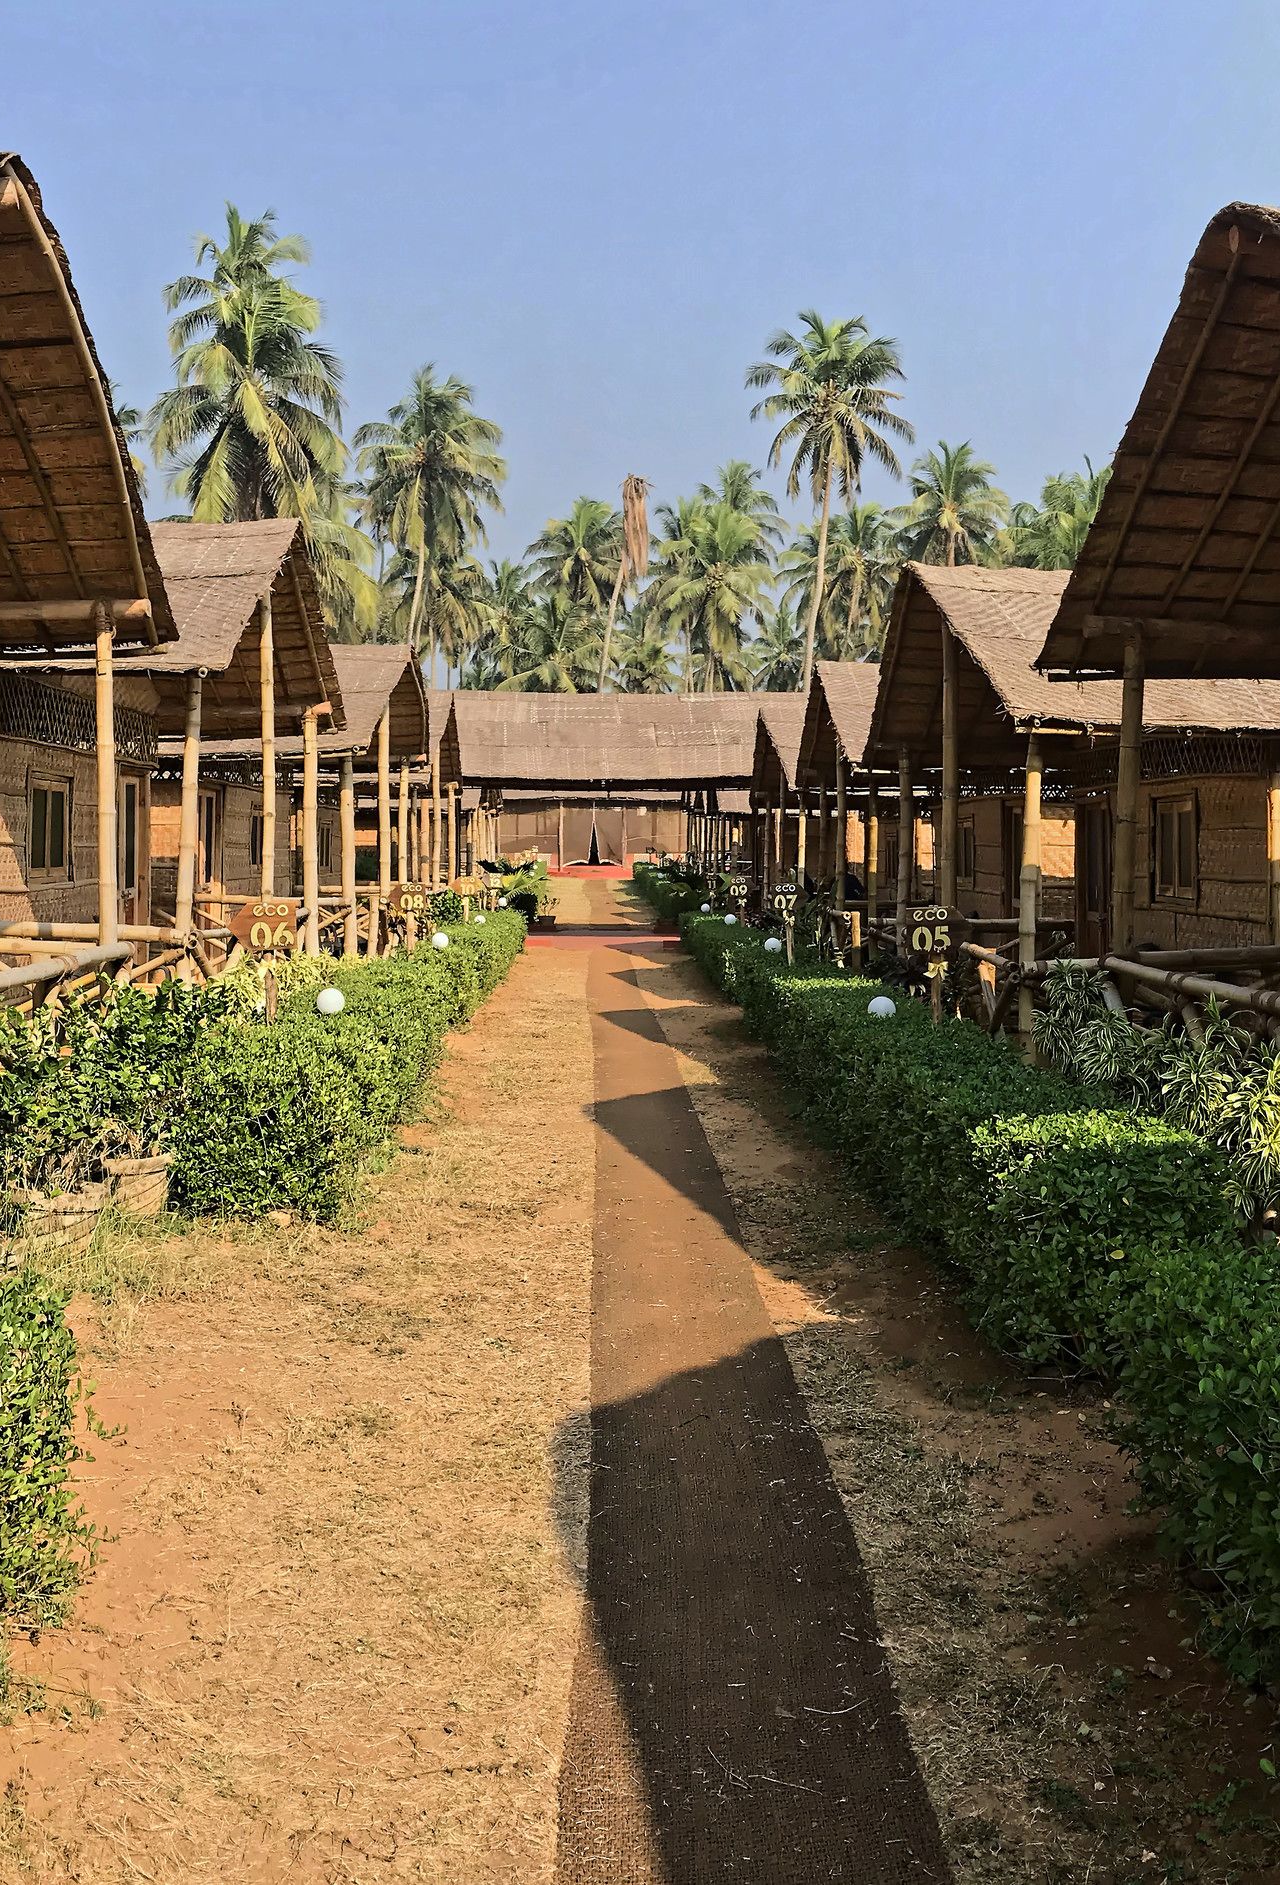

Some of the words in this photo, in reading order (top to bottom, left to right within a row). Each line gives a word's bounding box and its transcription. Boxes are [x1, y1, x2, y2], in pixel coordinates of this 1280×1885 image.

[401, 884, 423, 892] eco
[461, 884, 476, 896] 10
[707, 880, 717, 889] 11
[730, 884, 748, 896] 09
[775, 884, 796, 892] eco
[400, 894, 424, 910] 08
[774, 894, 798, 910] 07
[252, 904, 289, 917] eco
[913, 909, 948, 922] eco
[250, 921, 295, 949] 06
[912, 925, 951, 952] 05
